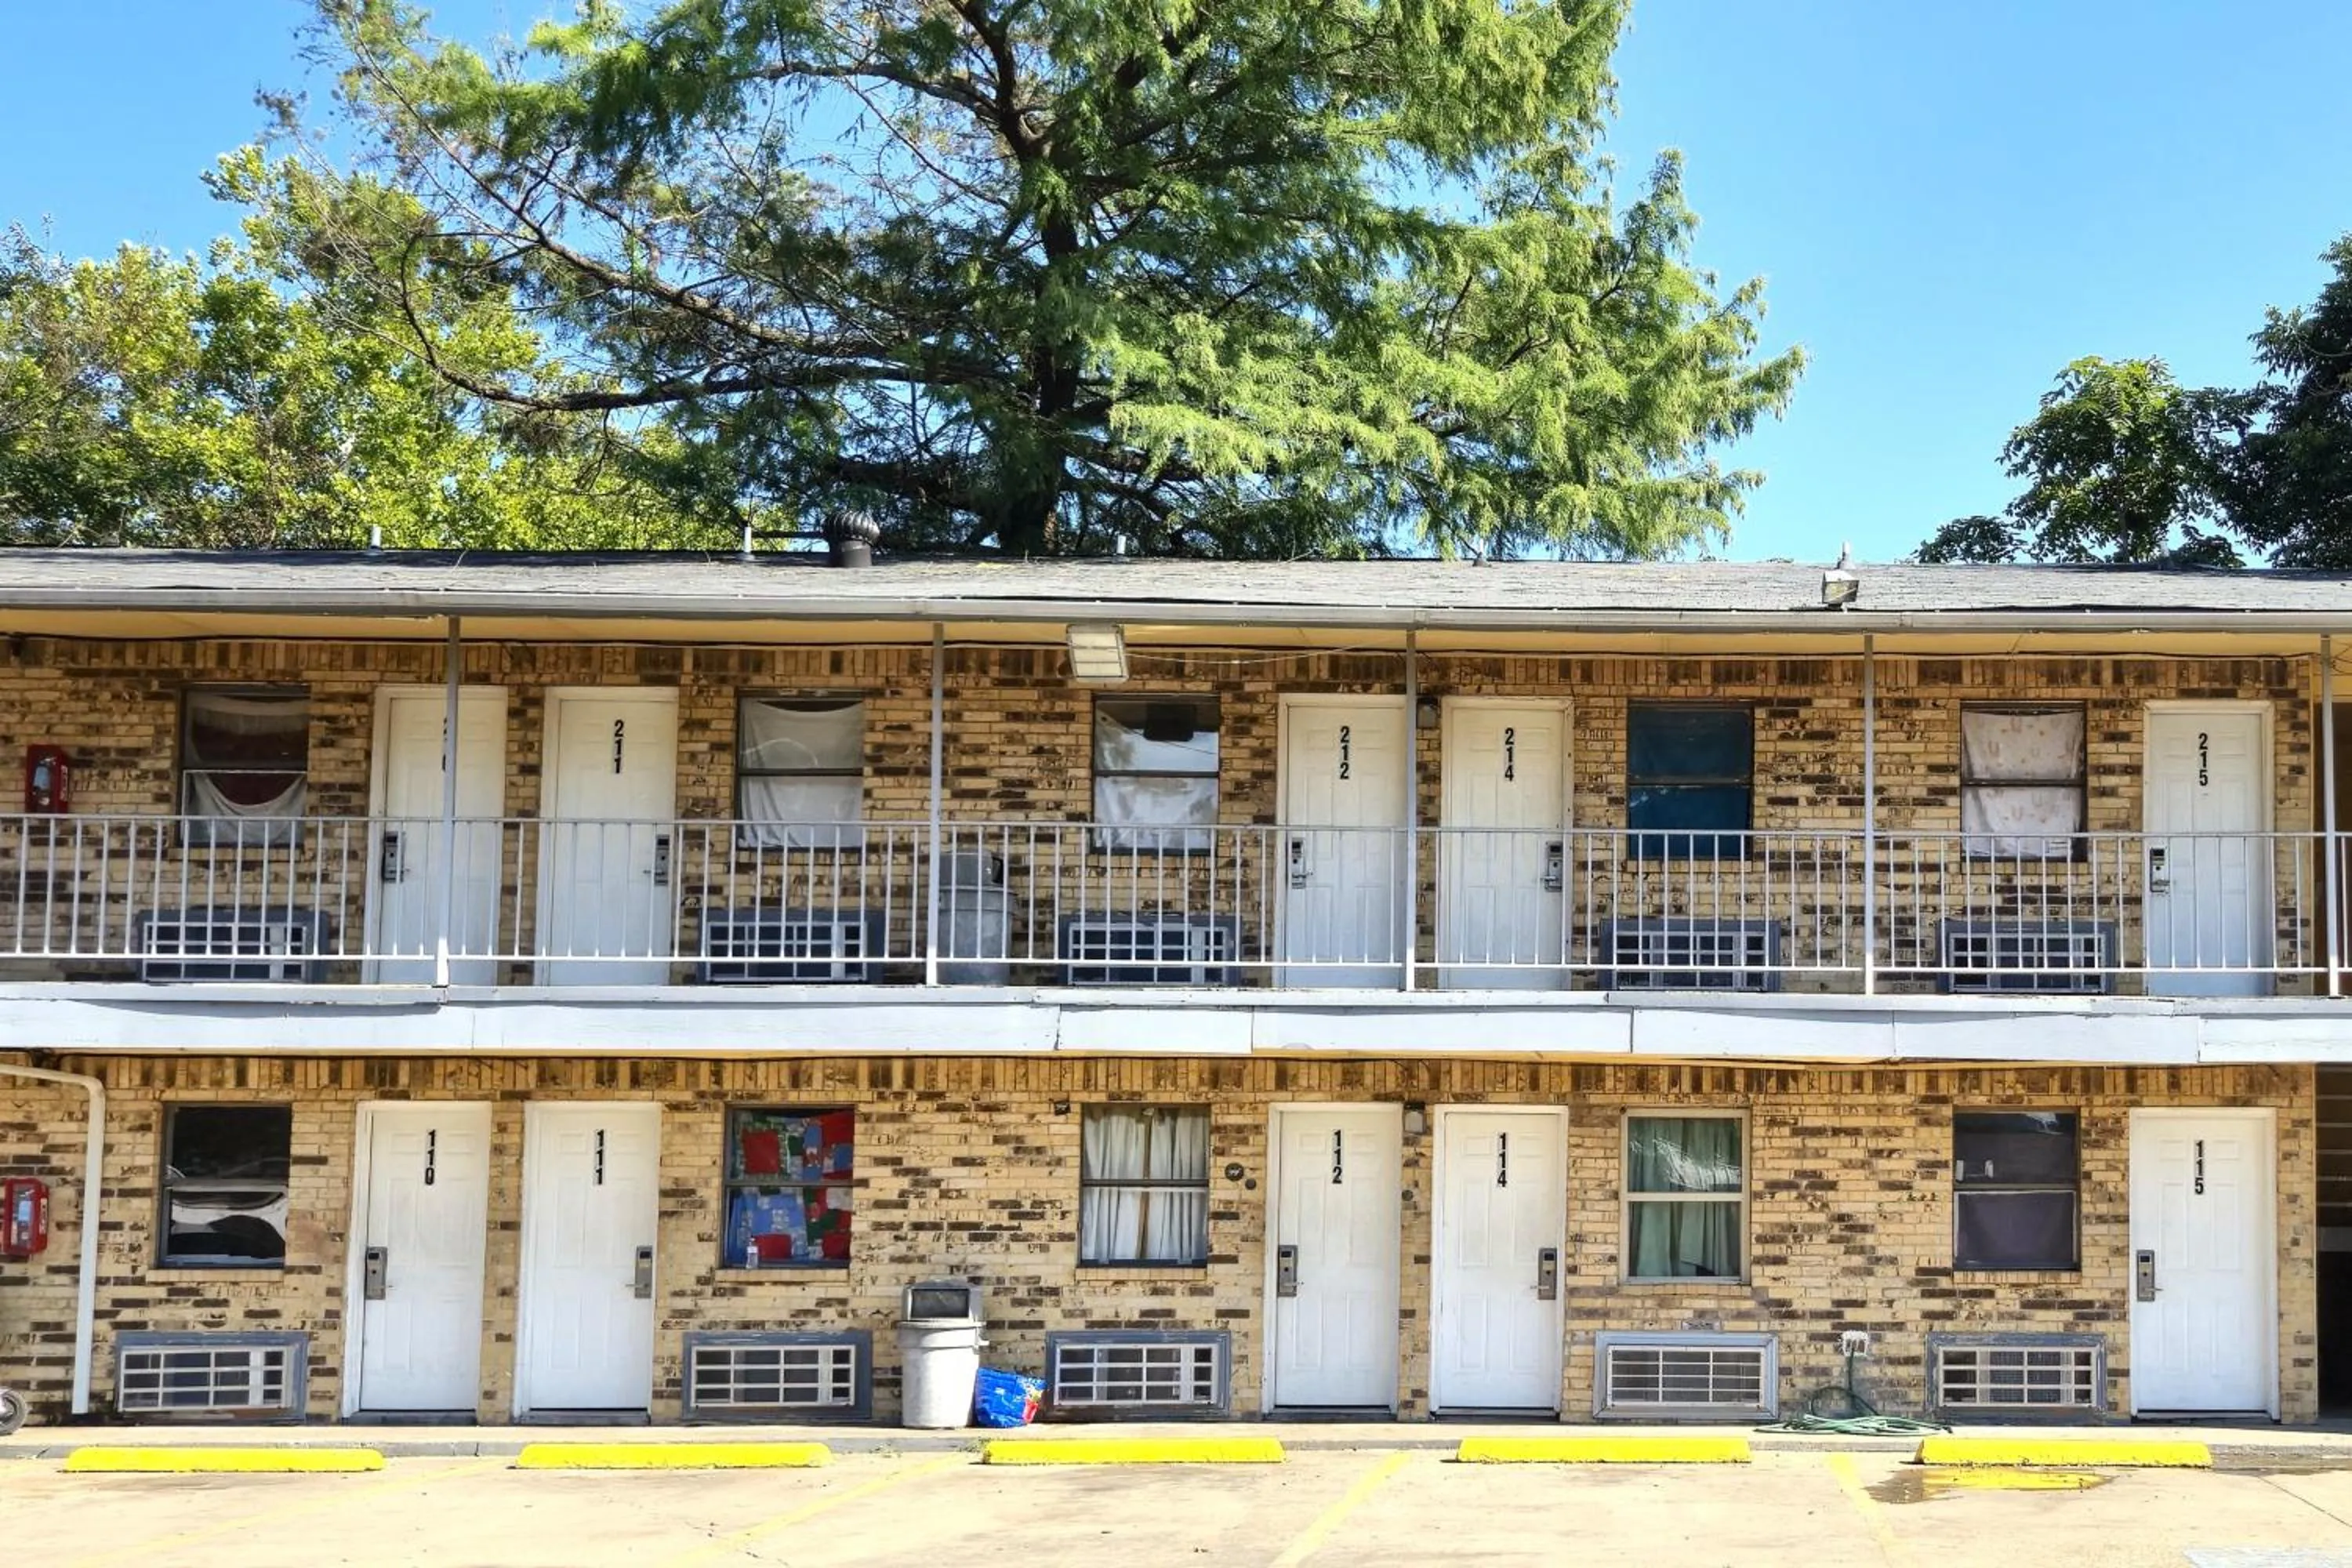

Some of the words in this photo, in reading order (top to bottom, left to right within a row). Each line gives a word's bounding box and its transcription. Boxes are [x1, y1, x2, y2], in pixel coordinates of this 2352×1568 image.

[613, 718, 626, 775] 211
[1339, 725, 1351, 780] 212
[1504, 727, 1515, 782] 214
[2198, 731, 2209, 787] 215
[424, 1129, 437, 1186] 110
[595, 1129, 604, 1185] 111
[1332, 1129, 1343, 1185] 112
[1497, 1132, 1508, 1188] 114
[2194, 1140, 2204, 1196] 115
